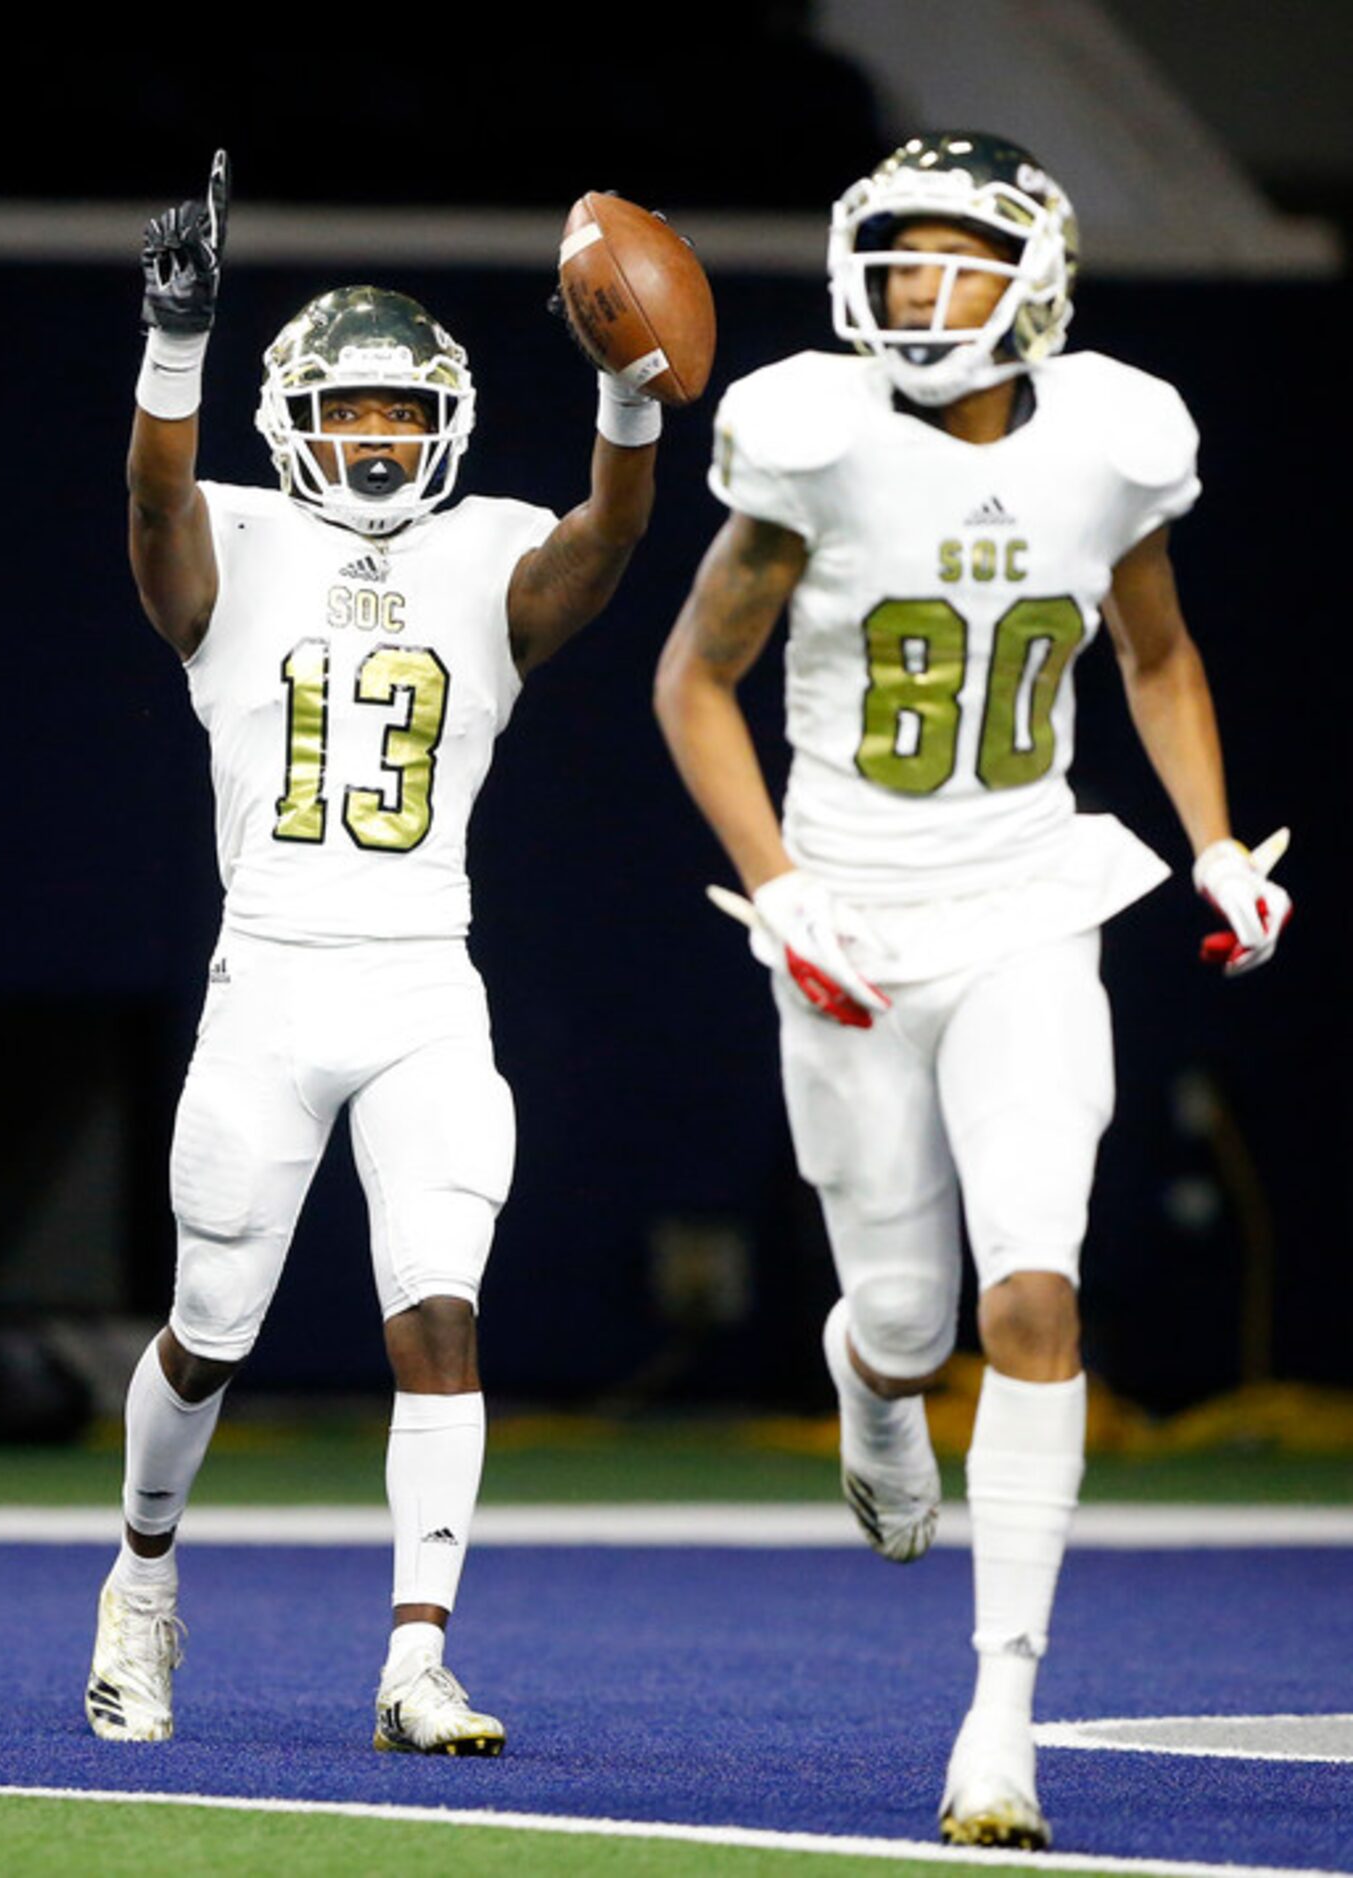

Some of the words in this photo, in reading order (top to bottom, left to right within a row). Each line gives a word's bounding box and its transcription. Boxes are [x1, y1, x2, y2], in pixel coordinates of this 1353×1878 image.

[327, 585, 405, 634] SOC
[938, 539, 1028, 583] SOC
[272, 637, 451, 853] 13
[855, 595, 1085, 796] 80
